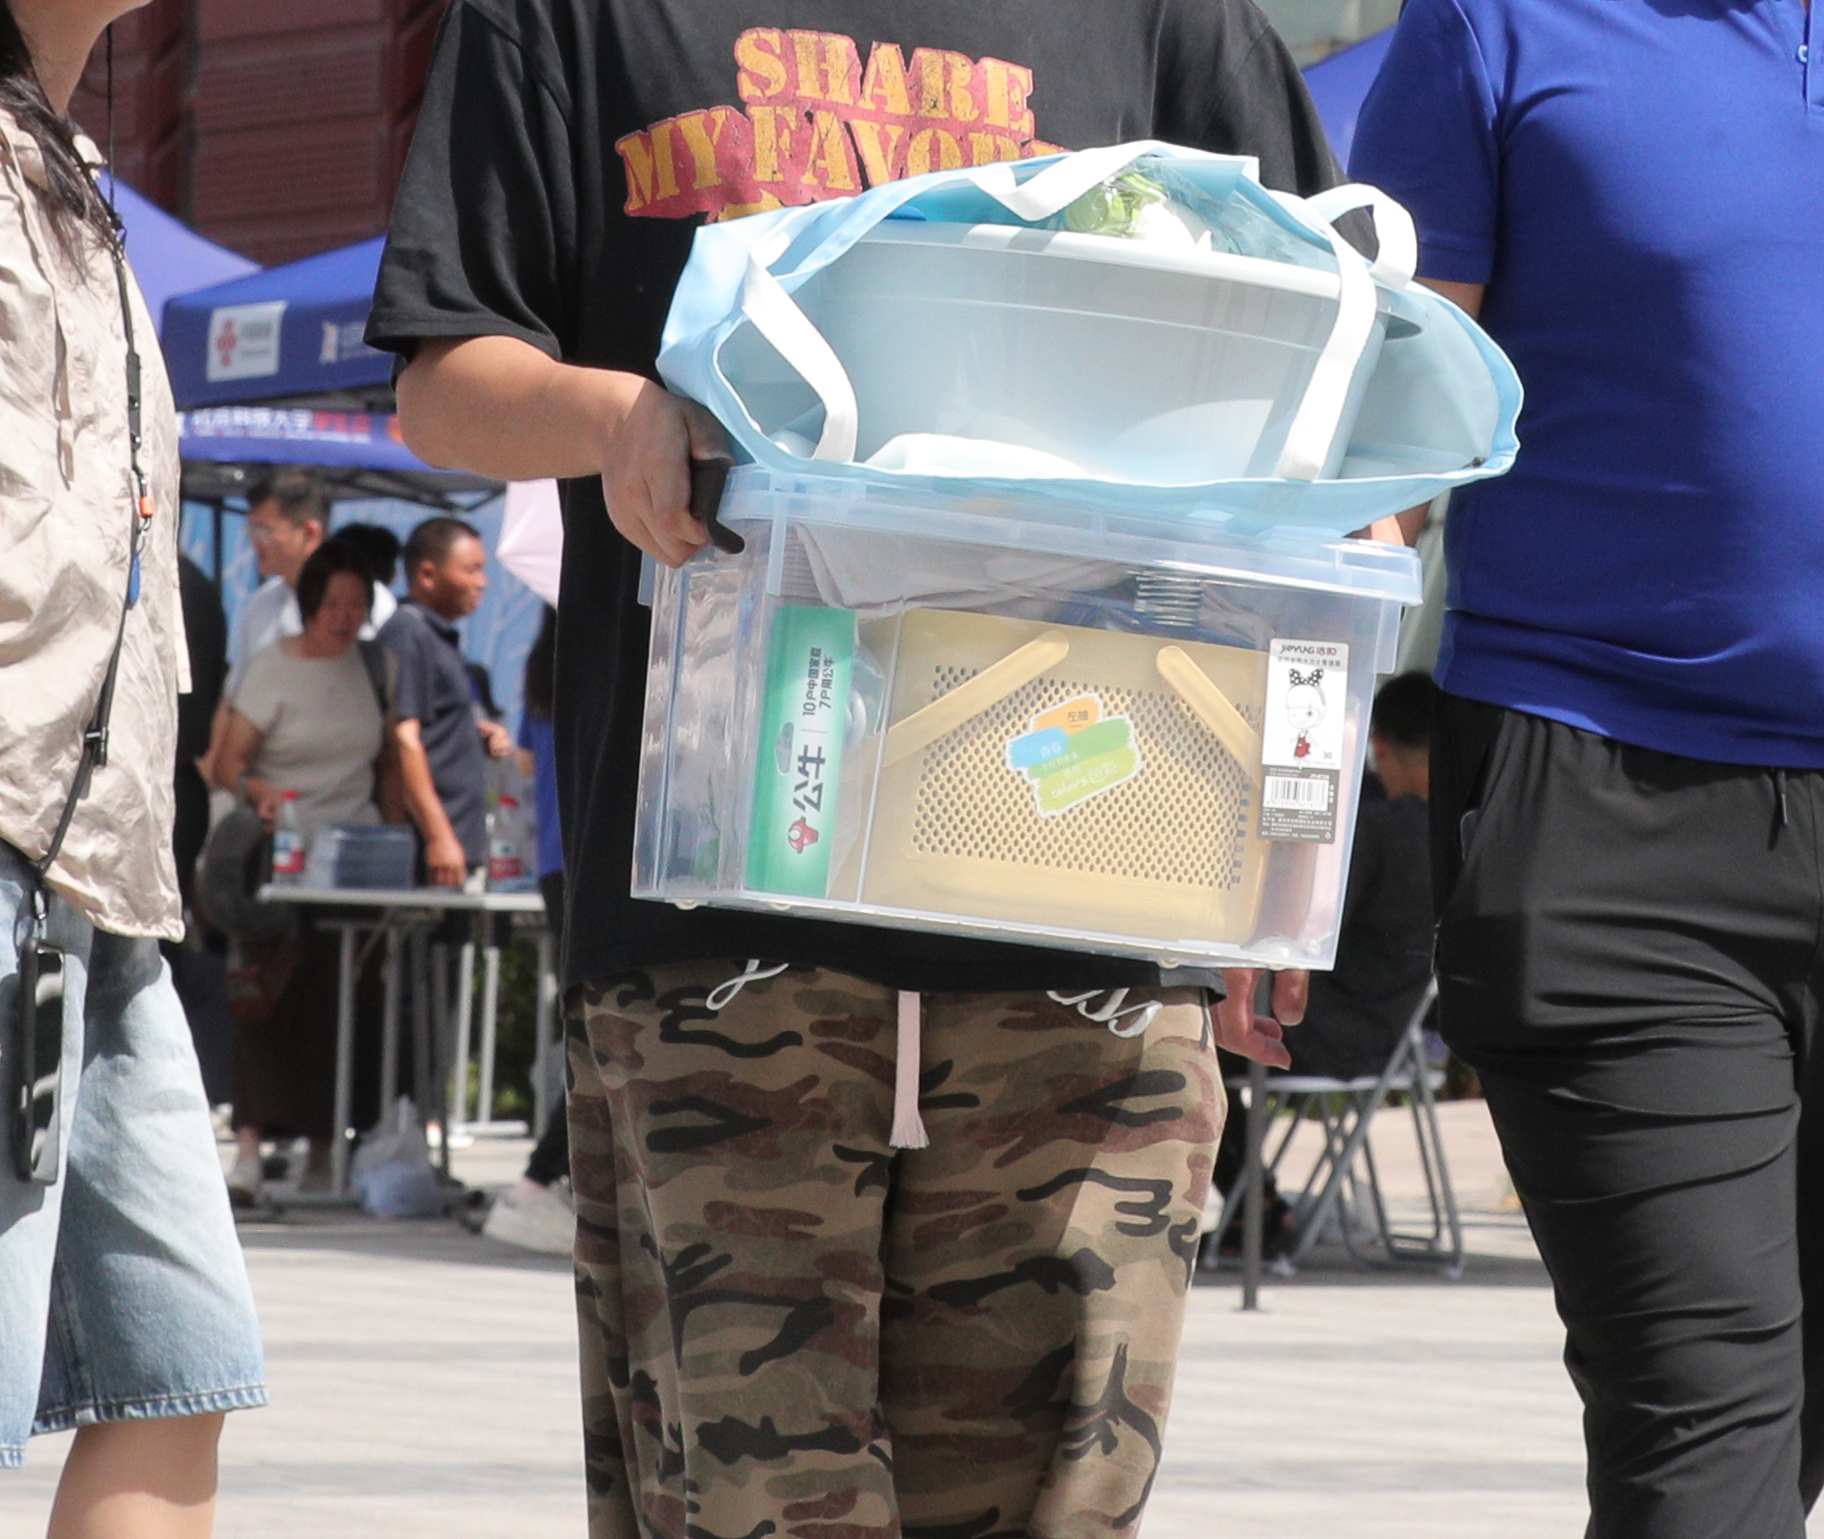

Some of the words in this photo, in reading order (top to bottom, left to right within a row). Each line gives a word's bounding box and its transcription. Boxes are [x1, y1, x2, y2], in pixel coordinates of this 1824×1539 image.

[735, 28, 1034, 137] SHARE
[619, 107, 732, 211] MY
[792, 744, 826, 812] 公牛
